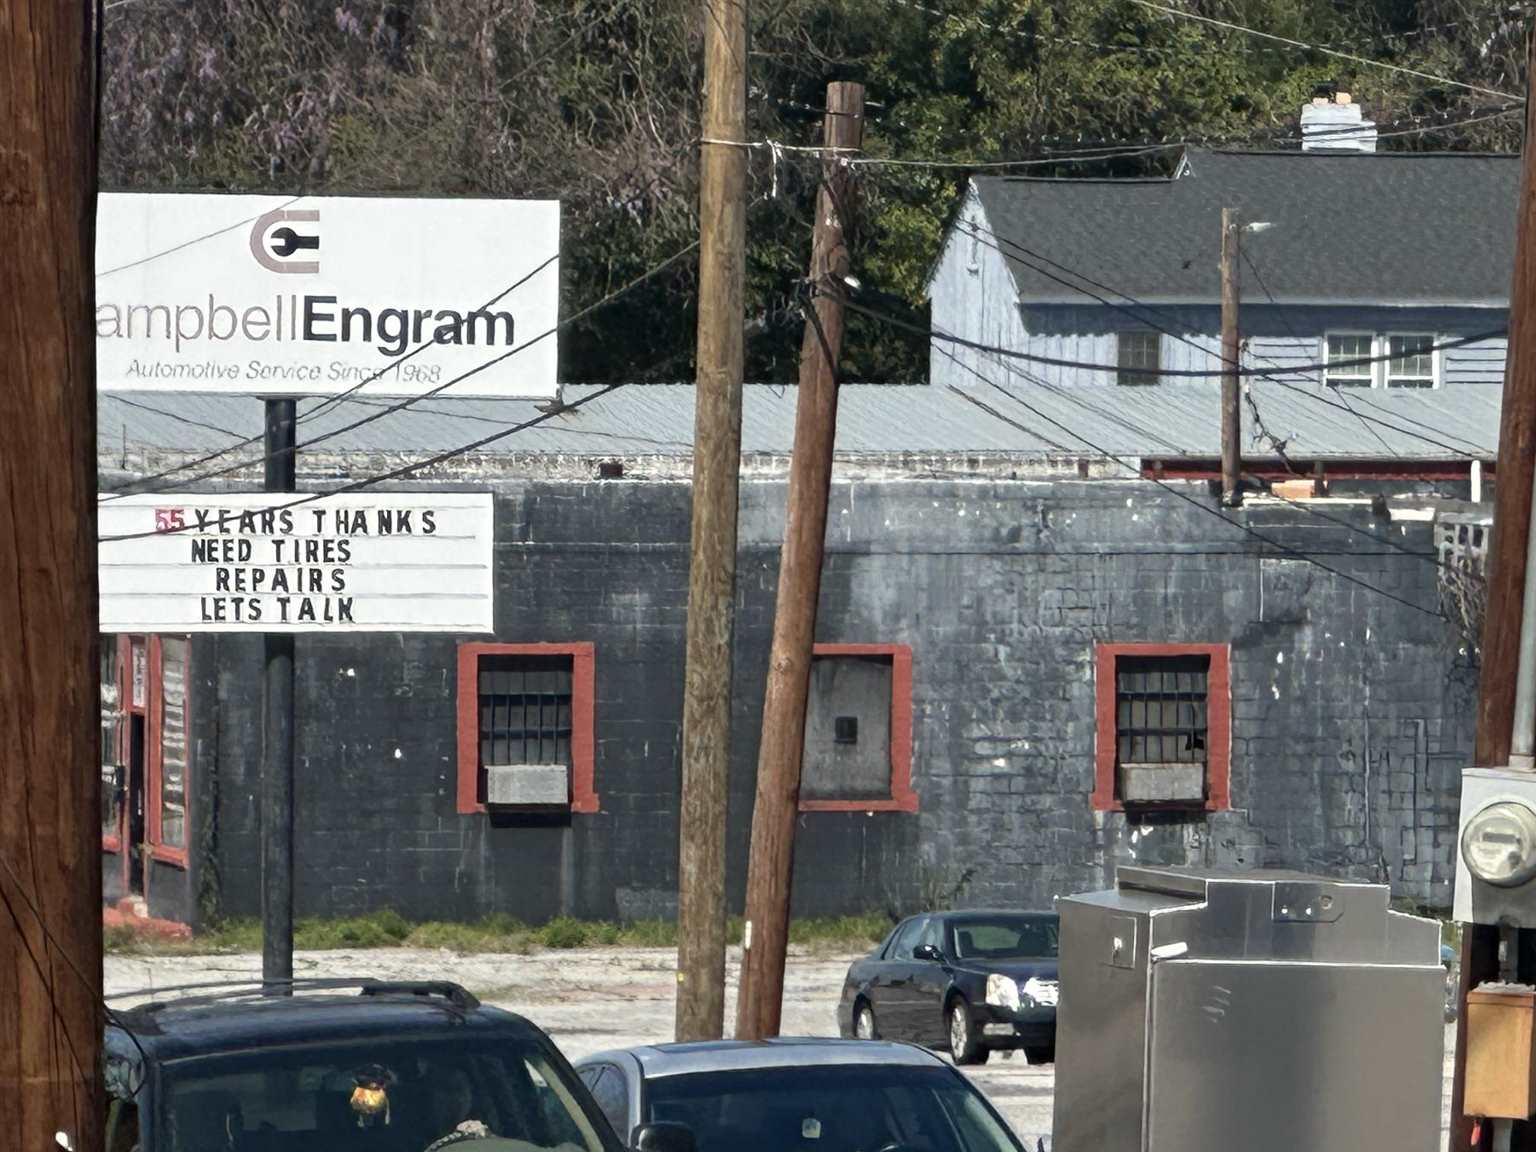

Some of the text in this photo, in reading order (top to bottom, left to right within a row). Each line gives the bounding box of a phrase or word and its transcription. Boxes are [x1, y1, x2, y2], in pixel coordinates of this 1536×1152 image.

[96, 293, 515, 357] ampbellEngram
[126, 359, 441, 384] Automotive Service Since 1968
[195, 509, 293, 534] YEARS
[313, 509, 437, 535] THANKS
[191, 538, 351, 564] NEED TIRES
[216, 567, 345, 593] REPAIRS
[201, 597, 353, 623] LETS TALK
